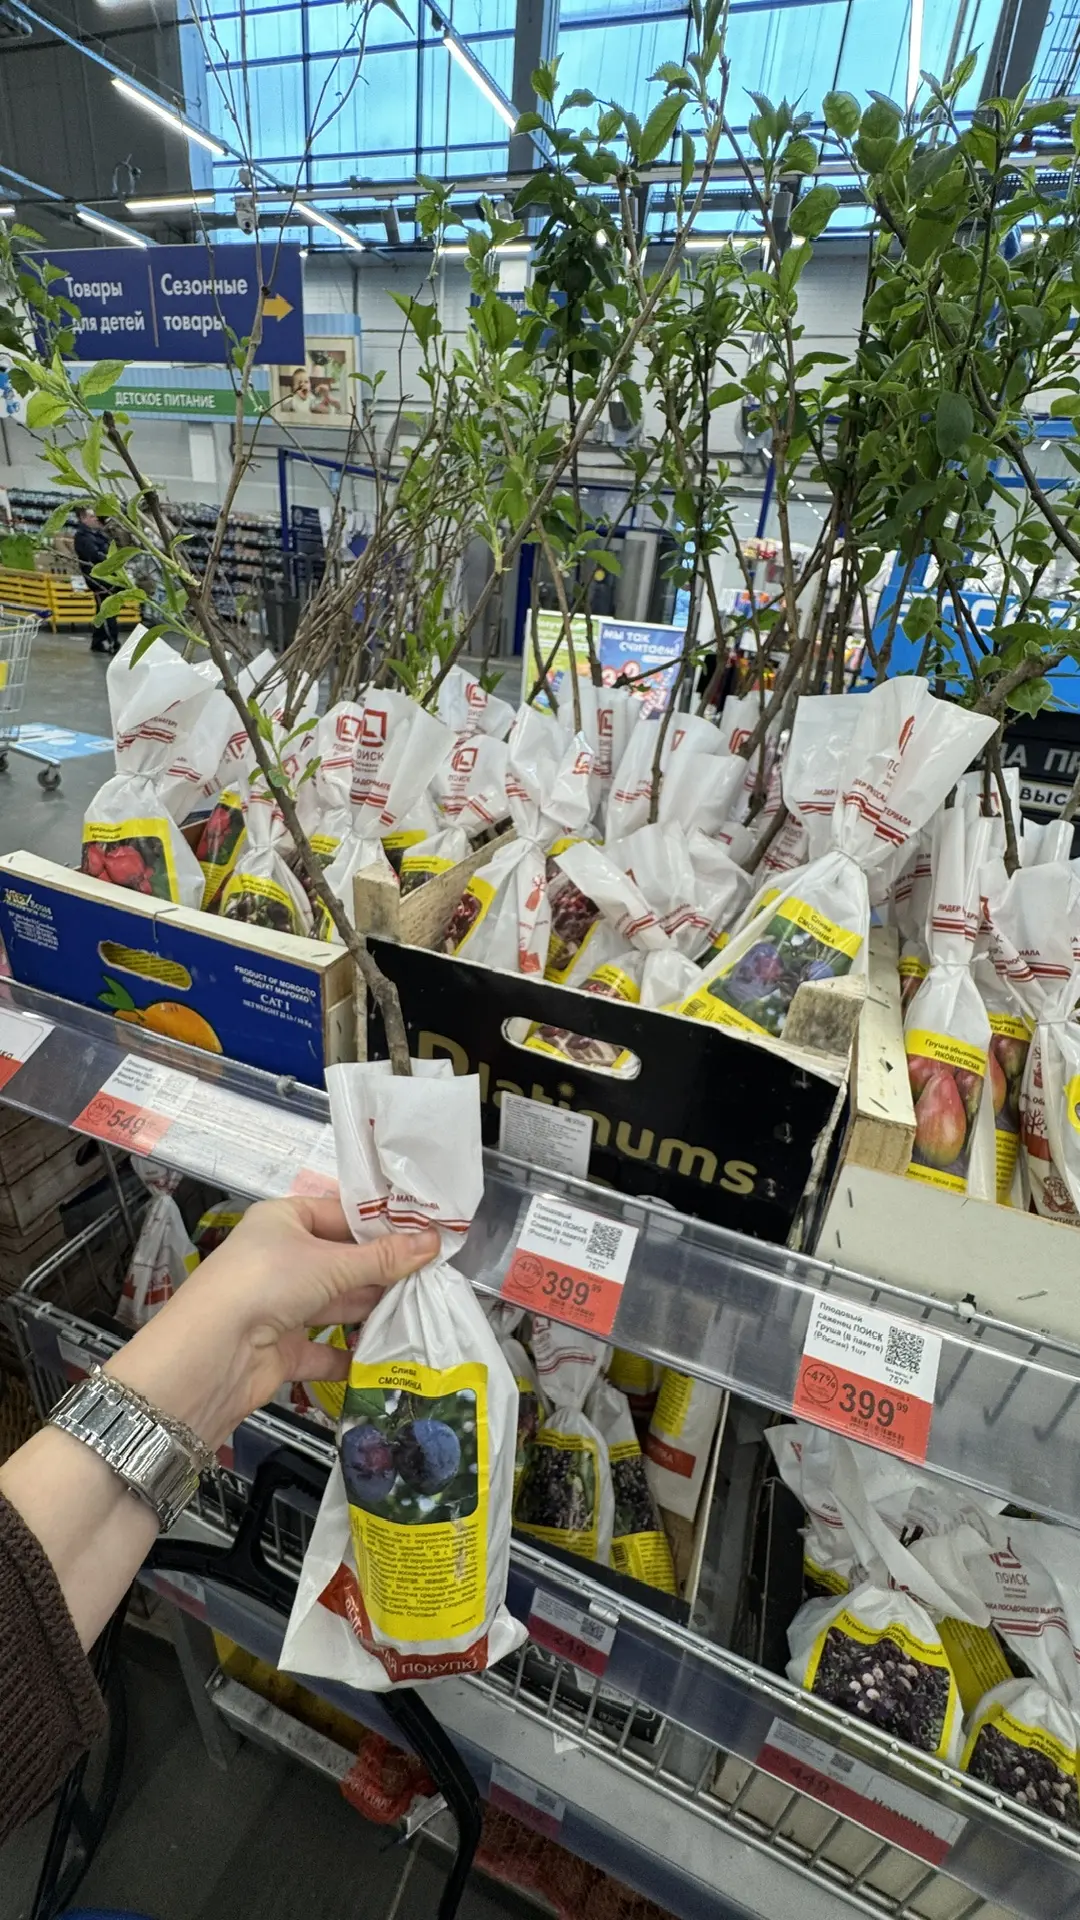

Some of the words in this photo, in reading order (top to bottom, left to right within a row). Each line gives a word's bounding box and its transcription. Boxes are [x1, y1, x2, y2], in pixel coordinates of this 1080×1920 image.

[64, 276, 123, 305] Товары
[160, 273, 248, 296] Сезонные
[72, 316, 98, 334] для
[100, 310, 145, 334] детей
[163, 314, 226, 337] товары
[115, 391, 164, 408] ДЕТСКОЕ
[164, 392, 217, 409] ПИТАНИЕ
[234, 965, 267, 981] PRODUCT
[268, 976, 278, 985] OF
[279, 980, 316, 998] MOROCCO
[242, 976, 273, 991] ПРОДУКТ
[260, 994, 283, 1009] CAT
[107, 1109, 147, 1136] 549
[542, 1270, 590, 1305] 399
[820, 1302, 863, 1322] Плодовый
[815, 1321, 842, 1336] Груша
[853, 1335, 884, 1354] пакете)
[818, 1313, 852, 1330] саженец
[853, 1324, 884, 1342] ПОИСК
[813, 1330, 849, 1352] (Россия)
[851, 1345, 867, 1356] 1шт
[391, 1366, 417, 1376] Слива
[806, 1369, 837, 1389] -47%
[378, 1376, 423, 1391] СМОЛИНКА
[838, 1382, 895, 1427] 399
[896, 1402, 909, 1414] 99
[995, 1571, 1030, 1586] ПОИСК
